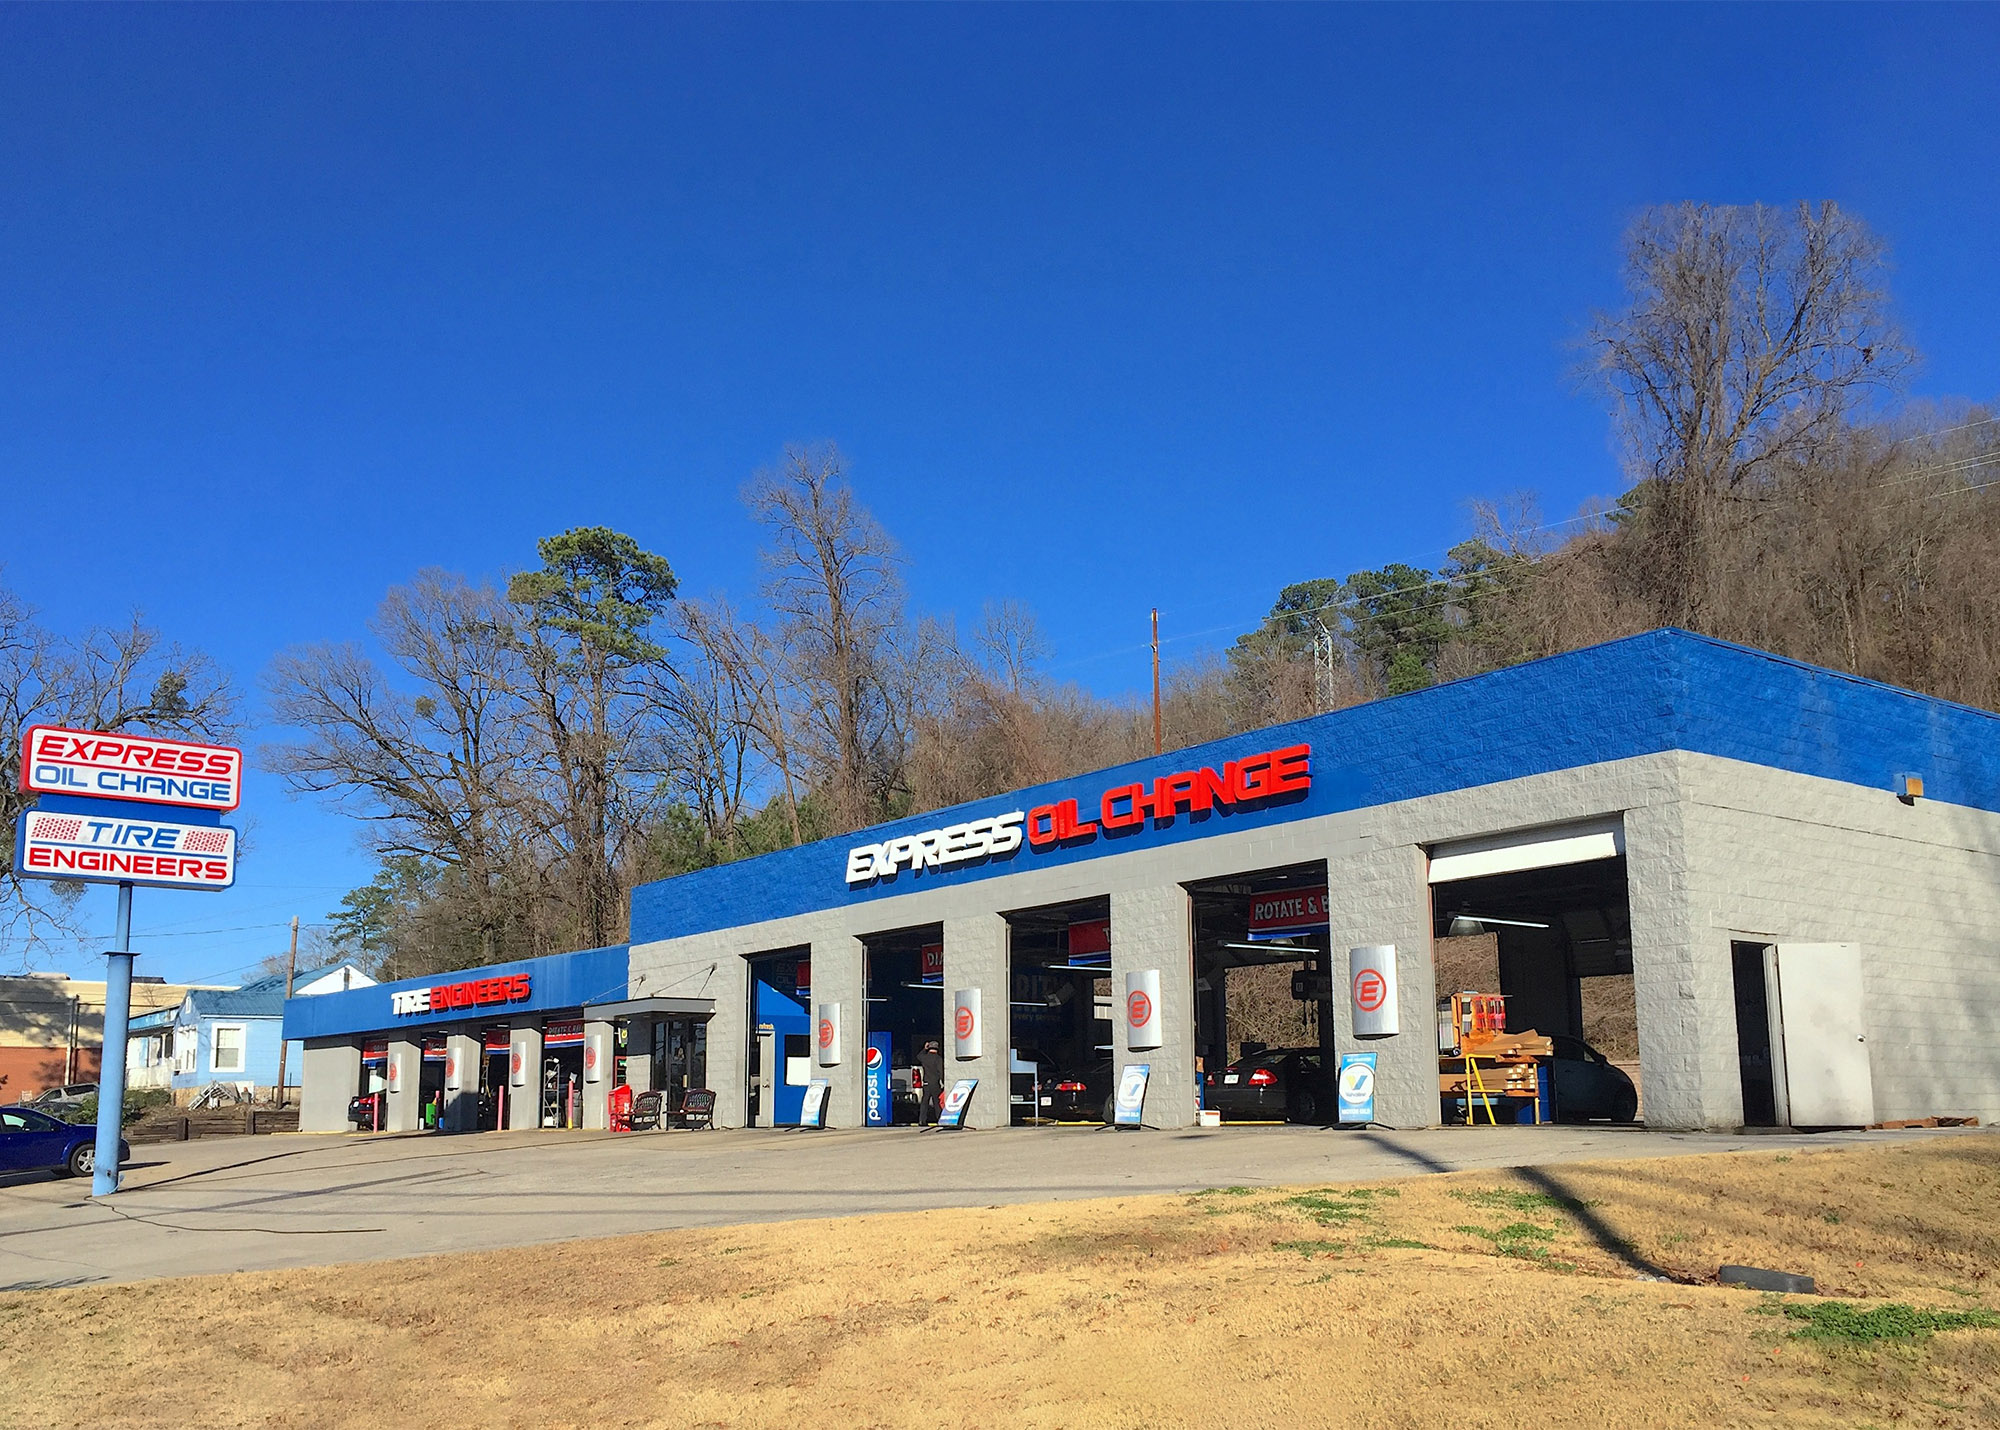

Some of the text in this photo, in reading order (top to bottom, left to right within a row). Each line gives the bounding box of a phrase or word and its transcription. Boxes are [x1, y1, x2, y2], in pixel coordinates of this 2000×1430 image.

[37, 735, 233, 775] EXPRESS
[35, 765, 230, 801] OIL CHANGE
[845, 743, 1311, 883] EXPRESS OIL CHANGE
[87, 822, 181, 849] TIRE
[28, 847, 227, 880] ENGINEERS
[1255, 899, 1303, 921] ROTATE
[1307, 896, 1318, 915] &
[391, 973, 530, 1015] TIRE ENGINEERS
[867, 1072, 881, 1121] pepsi
